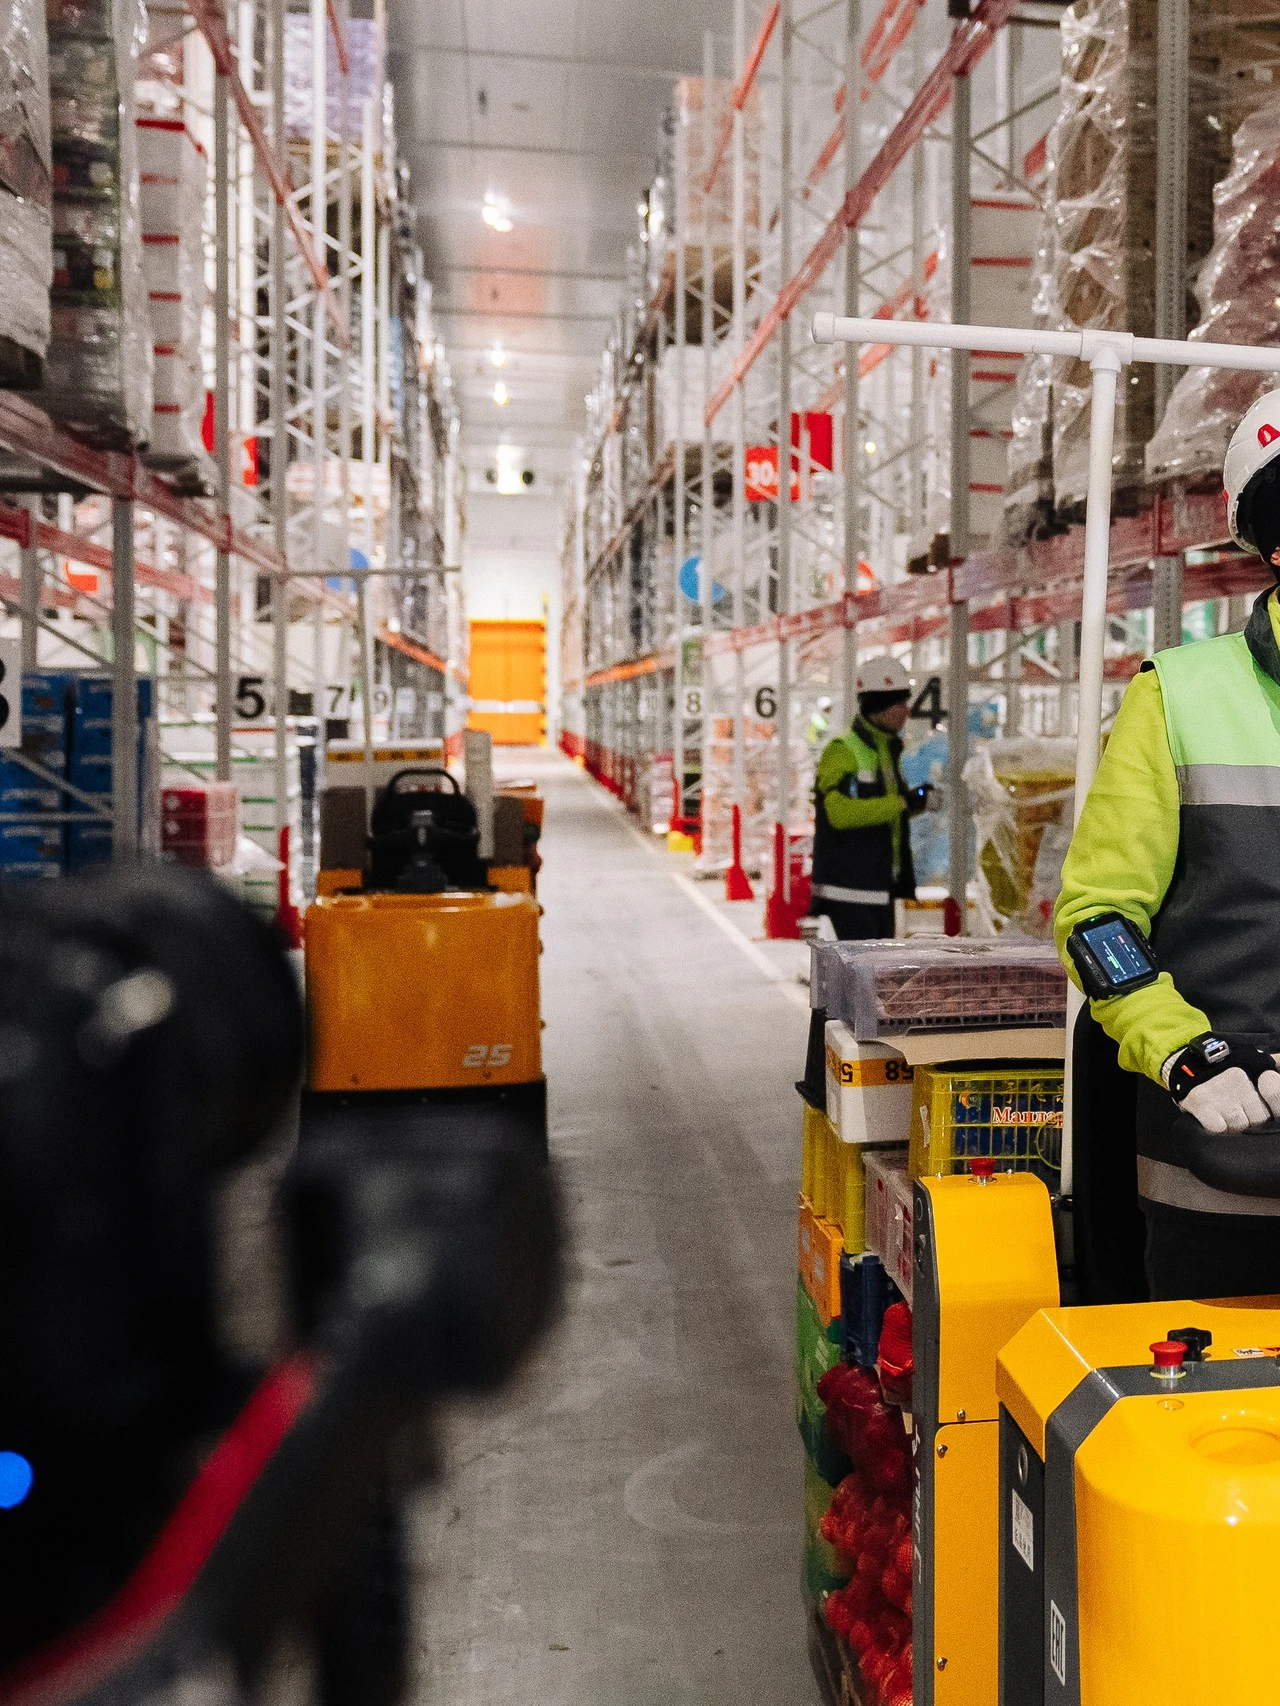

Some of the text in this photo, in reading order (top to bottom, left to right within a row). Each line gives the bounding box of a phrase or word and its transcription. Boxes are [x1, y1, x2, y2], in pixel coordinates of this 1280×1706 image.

[236, 677, 266, 719] 5
[327, 687, 345, 712] 7
[686, 691, 702, 715] 8
[755, 686, 778, 719] 6
[909, 676, 948, 729] 4
[463, 1044, 513, 1069] 25
